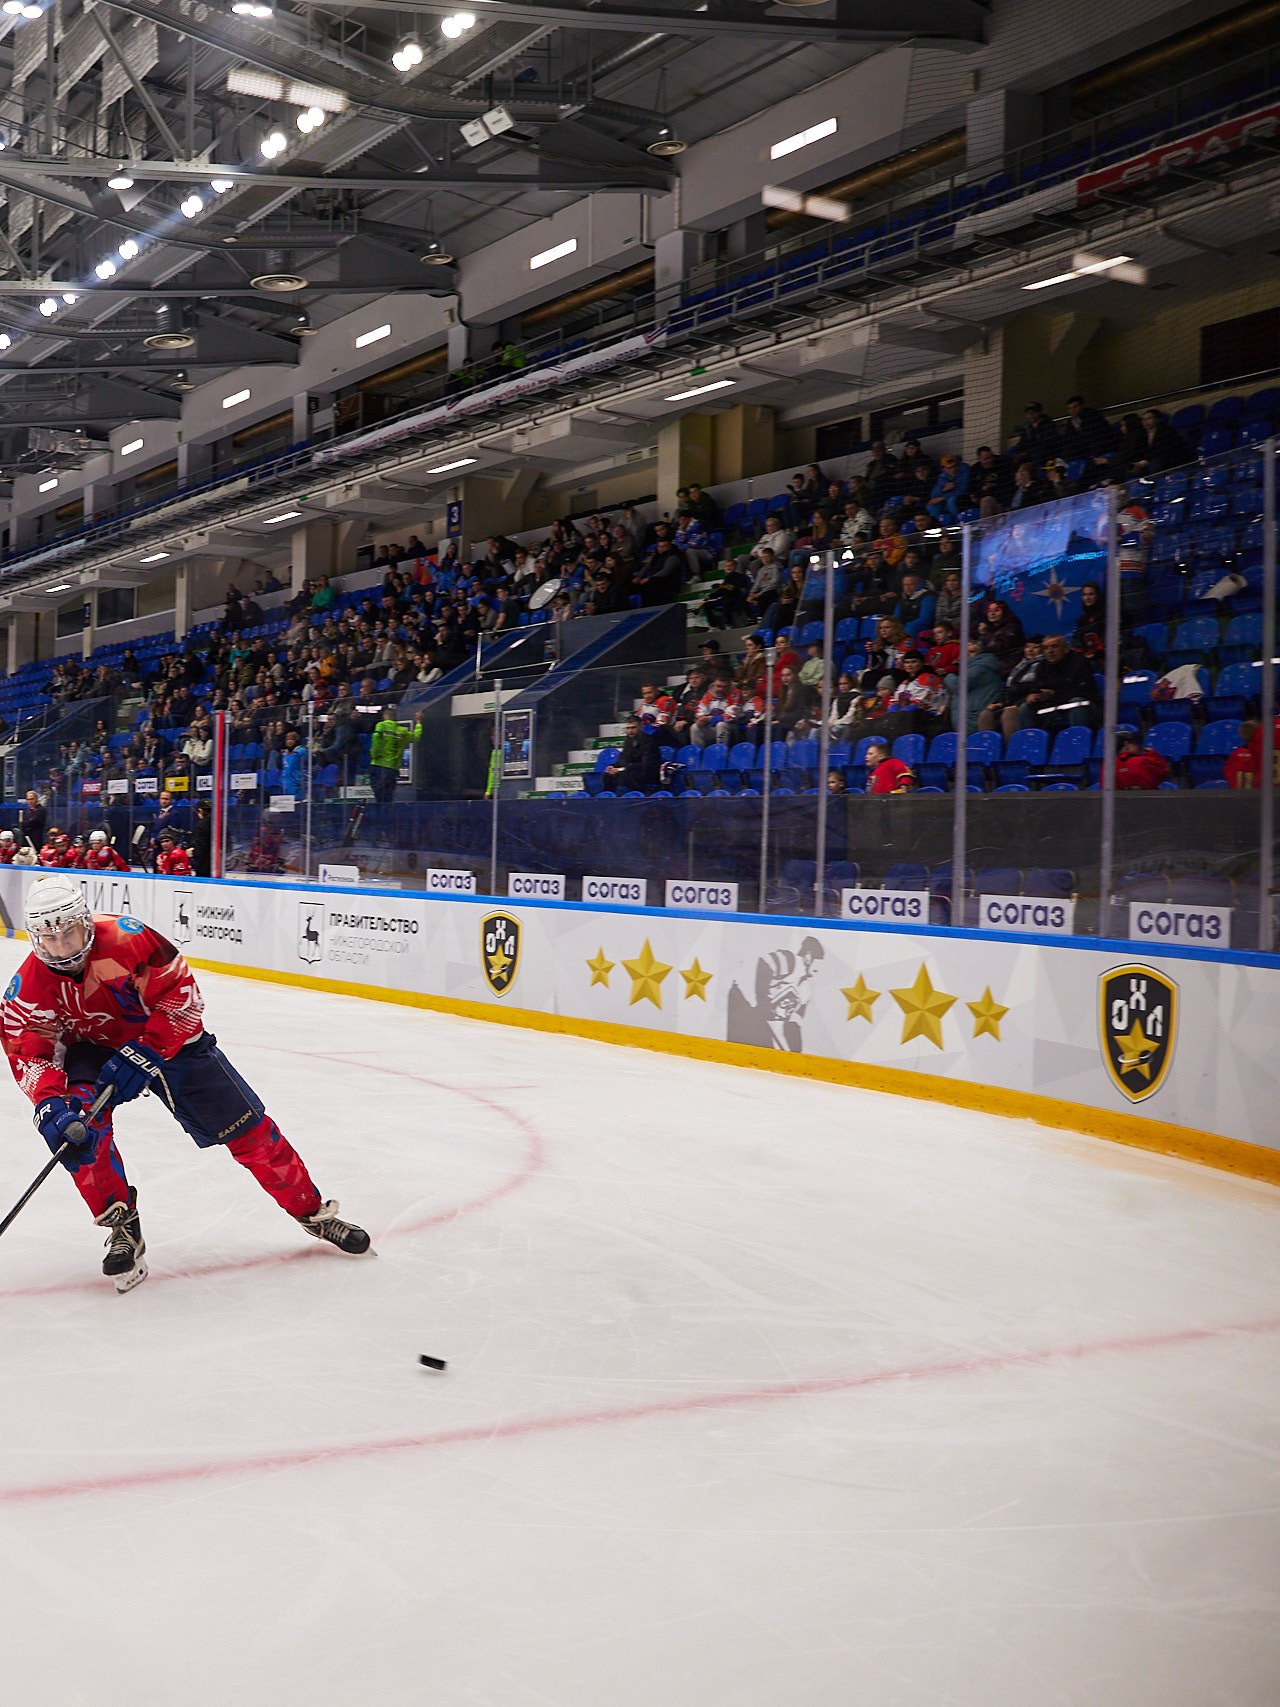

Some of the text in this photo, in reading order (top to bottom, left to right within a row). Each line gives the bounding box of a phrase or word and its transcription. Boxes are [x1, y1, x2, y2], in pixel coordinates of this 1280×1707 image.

[450, 506, 459, 523] 3
[196, 904, 236, 922] НИЖНИЙ
[329, 912, 420, 935] ПРАВИТЕЛЬСТВО
[196, 924, 243, 945] НОВГОРОД
[217, 1108, 254, 1139] EASTON
